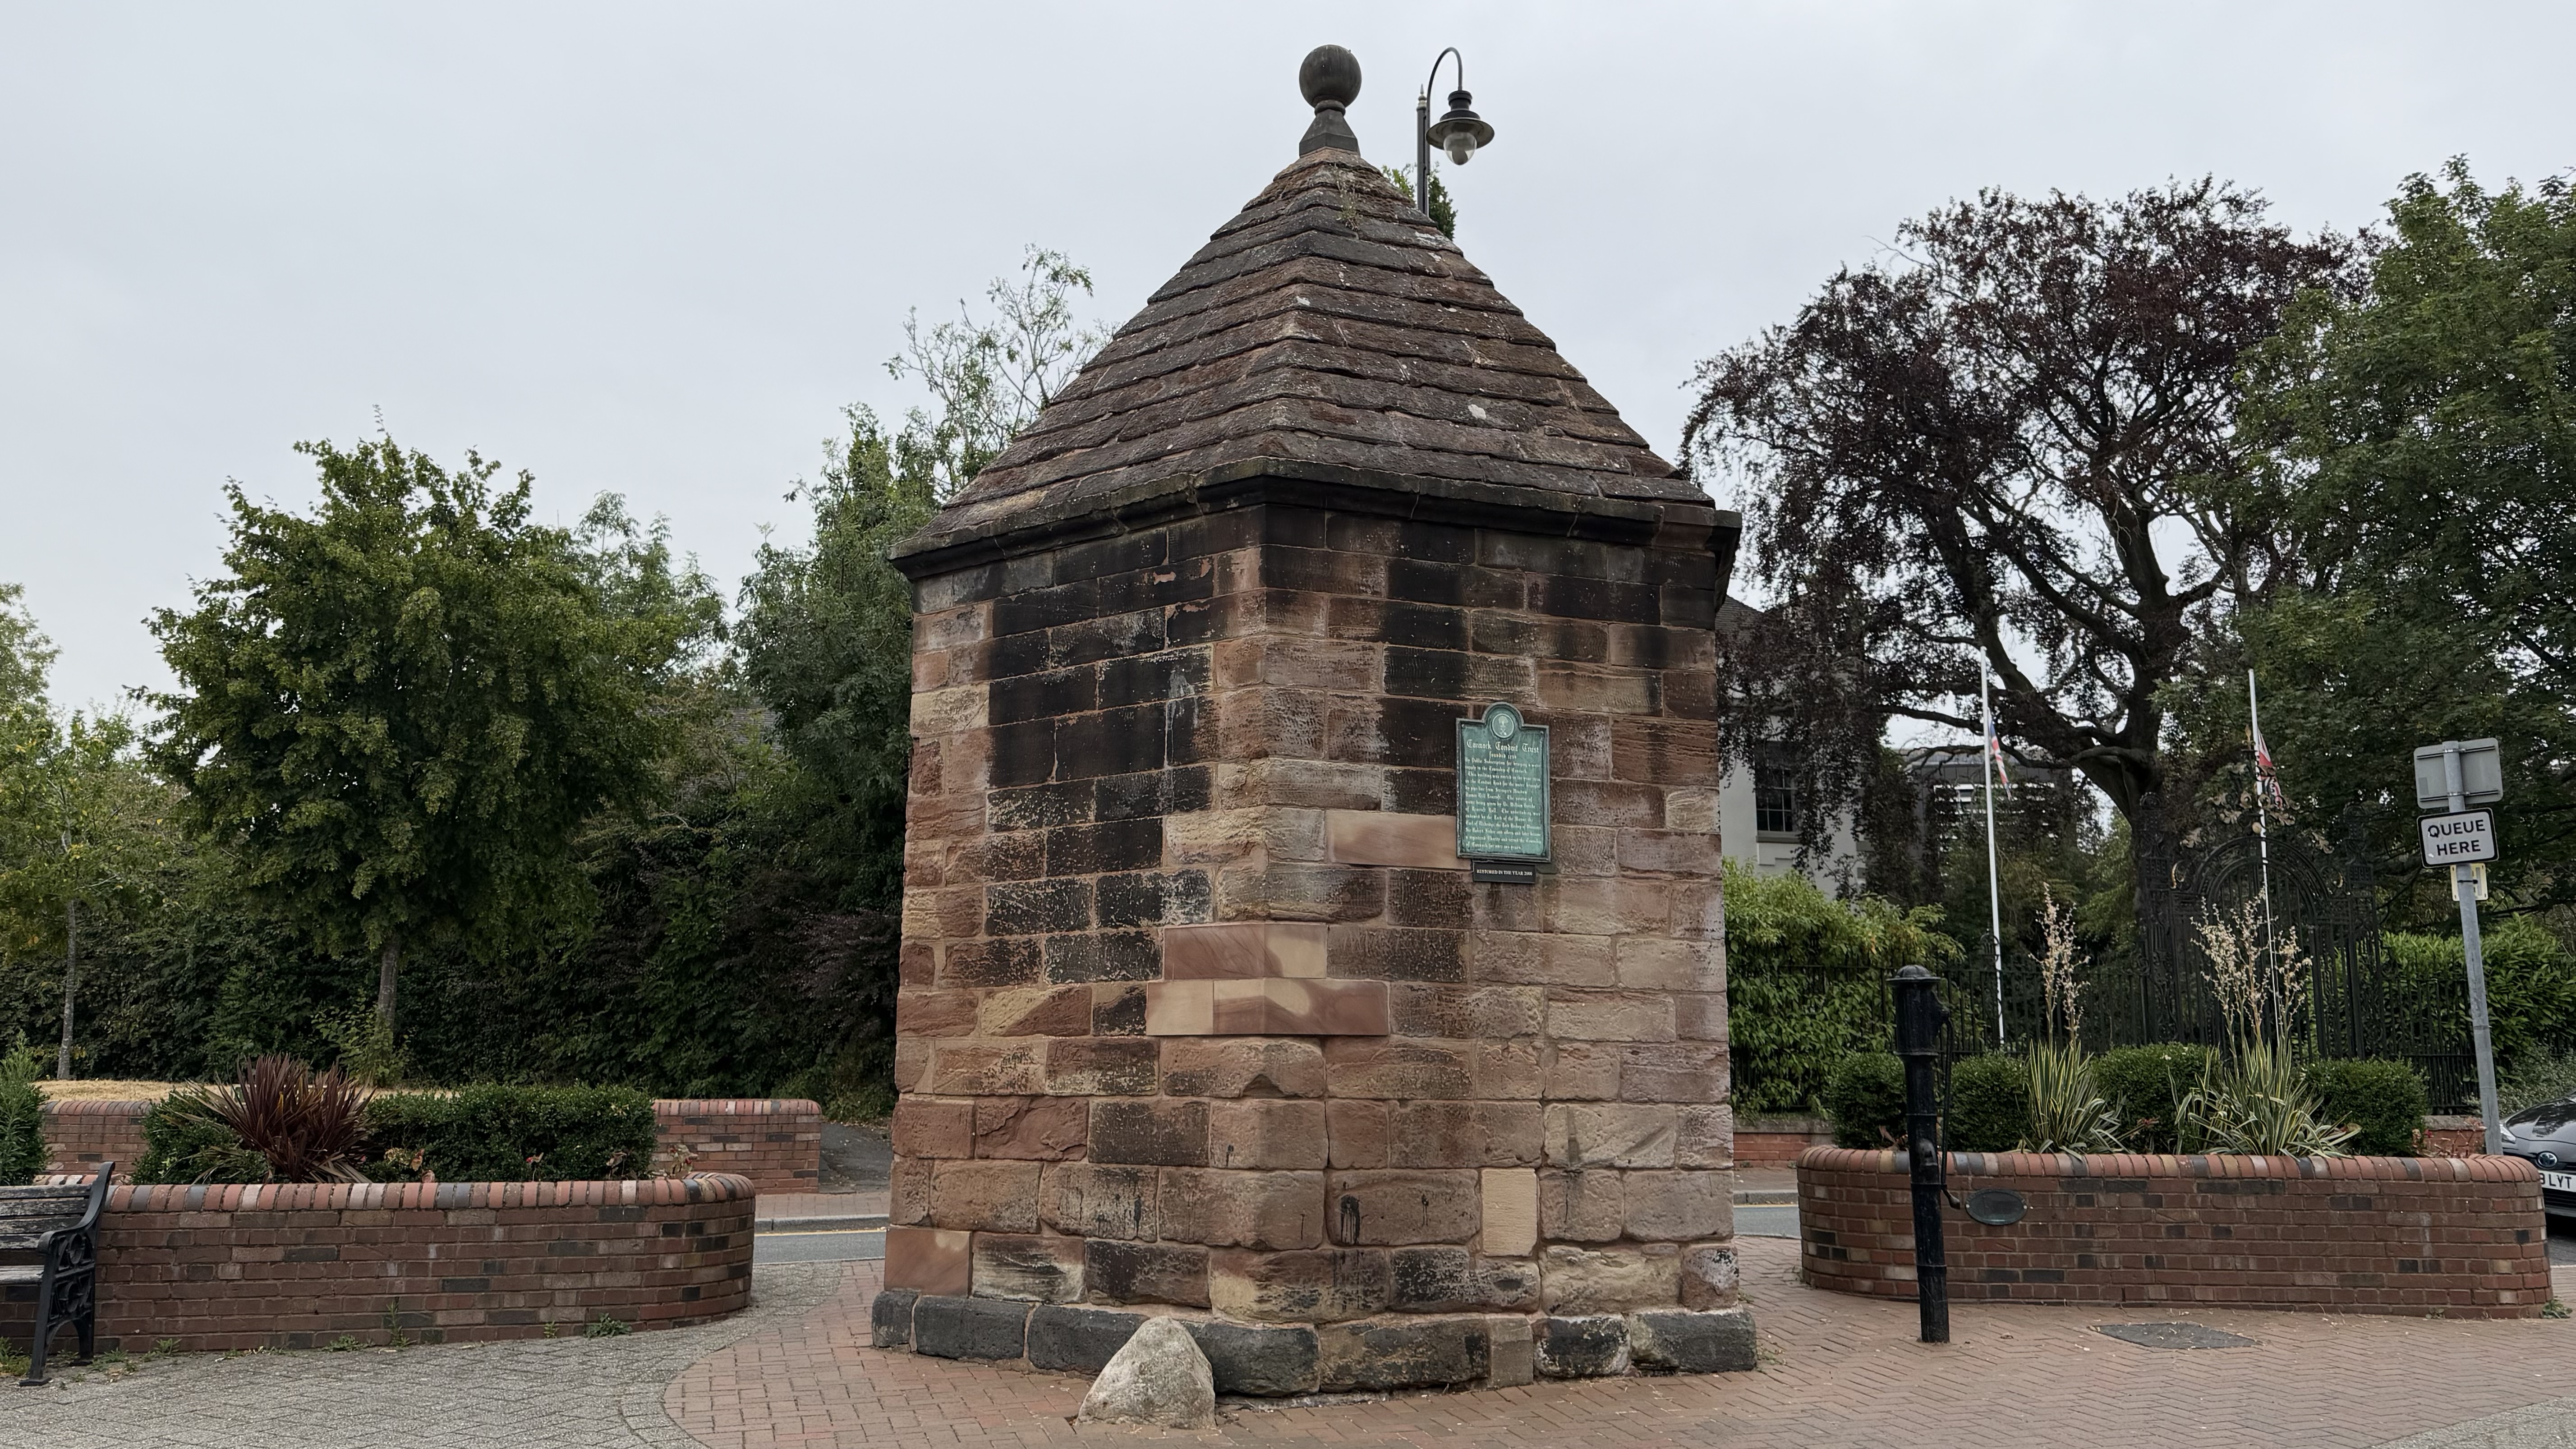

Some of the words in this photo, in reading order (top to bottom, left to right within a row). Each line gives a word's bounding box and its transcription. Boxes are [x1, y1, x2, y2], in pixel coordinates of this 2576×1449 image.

[1467, 739, 1492, 749] Cannock
[1495, 741, 1518, 752] Conduit
[1522, 743, 1539, 754] Trust
[2428, 819, 2485, 838] QUEUE
[2437, 840, 2481, 856] HERE
[2548, 1173, 2572, 1189] LYT
